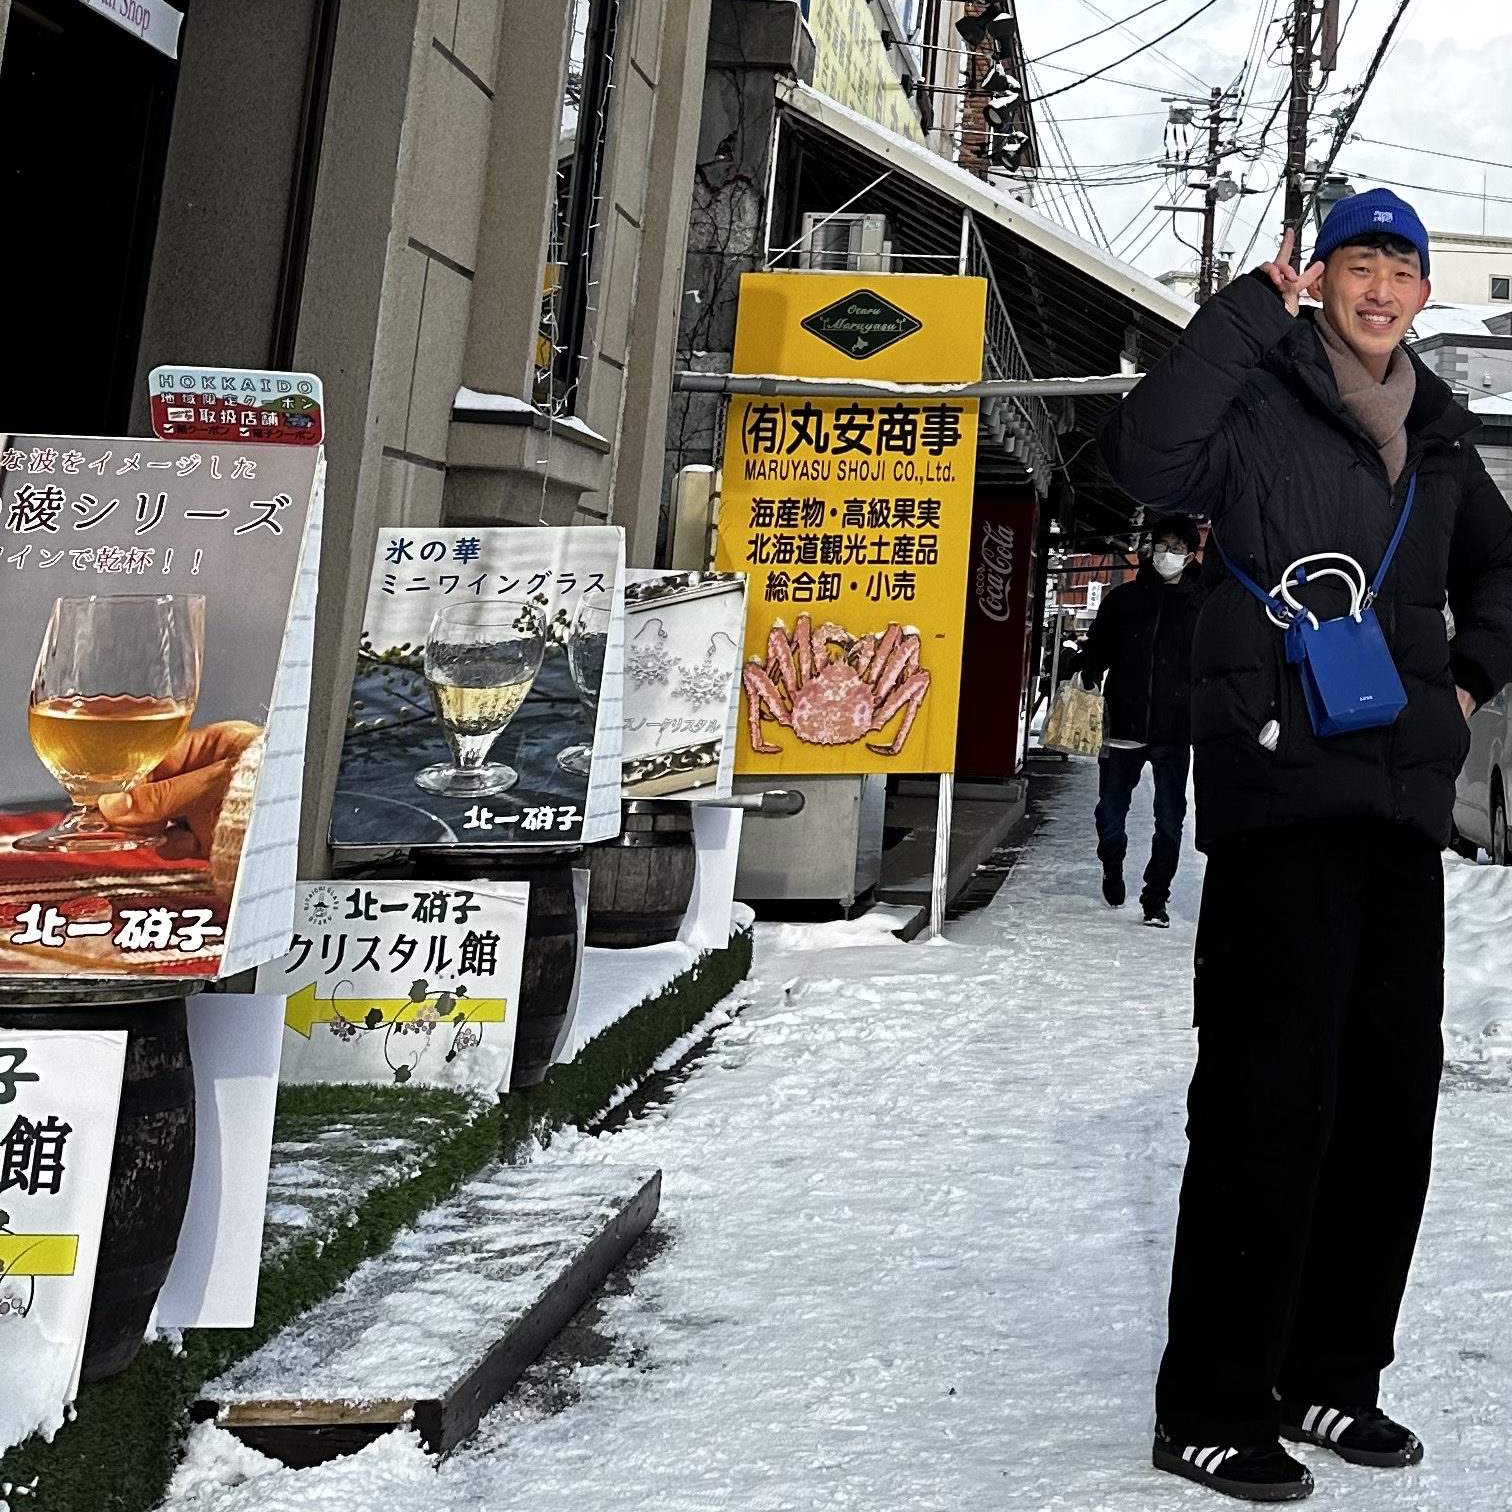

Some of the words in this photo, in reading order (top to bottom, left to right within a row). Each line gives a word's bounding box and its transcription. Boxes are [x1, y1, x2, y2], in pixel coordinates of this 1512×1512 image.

[159, 374, 313, 394] HOKKAIDO
[199, 408, 279, 426] 取扱店舗
[0, 447, 258, 480] な波をイメージした
[745, 460, 831, 481] MARUYASU
[837, 460, 886, 482] SHOJI
[0, 483, 293, 535] 綾シリーズ
[749, 497, 941, 529] 海産物・高級果実
[0, 544, 204, 575] インで乾杯！！
[385, 538, 481, 565] 氷の華
[746, 533, 937, 565] 北海道観光土産品
[382, 570, 606, 595] ミニワイングラス
[765, 571, 916, 602] 総合卸・小売
[621, 717, 721, 733] スノークリスタル
[462, 805, 583, 831] 北一硝子
[345, 888, 481, 924] 北一硝子
[11, 903, 223, 951] 北一硝子
[285, 930, 500, 977] クリスタル館
